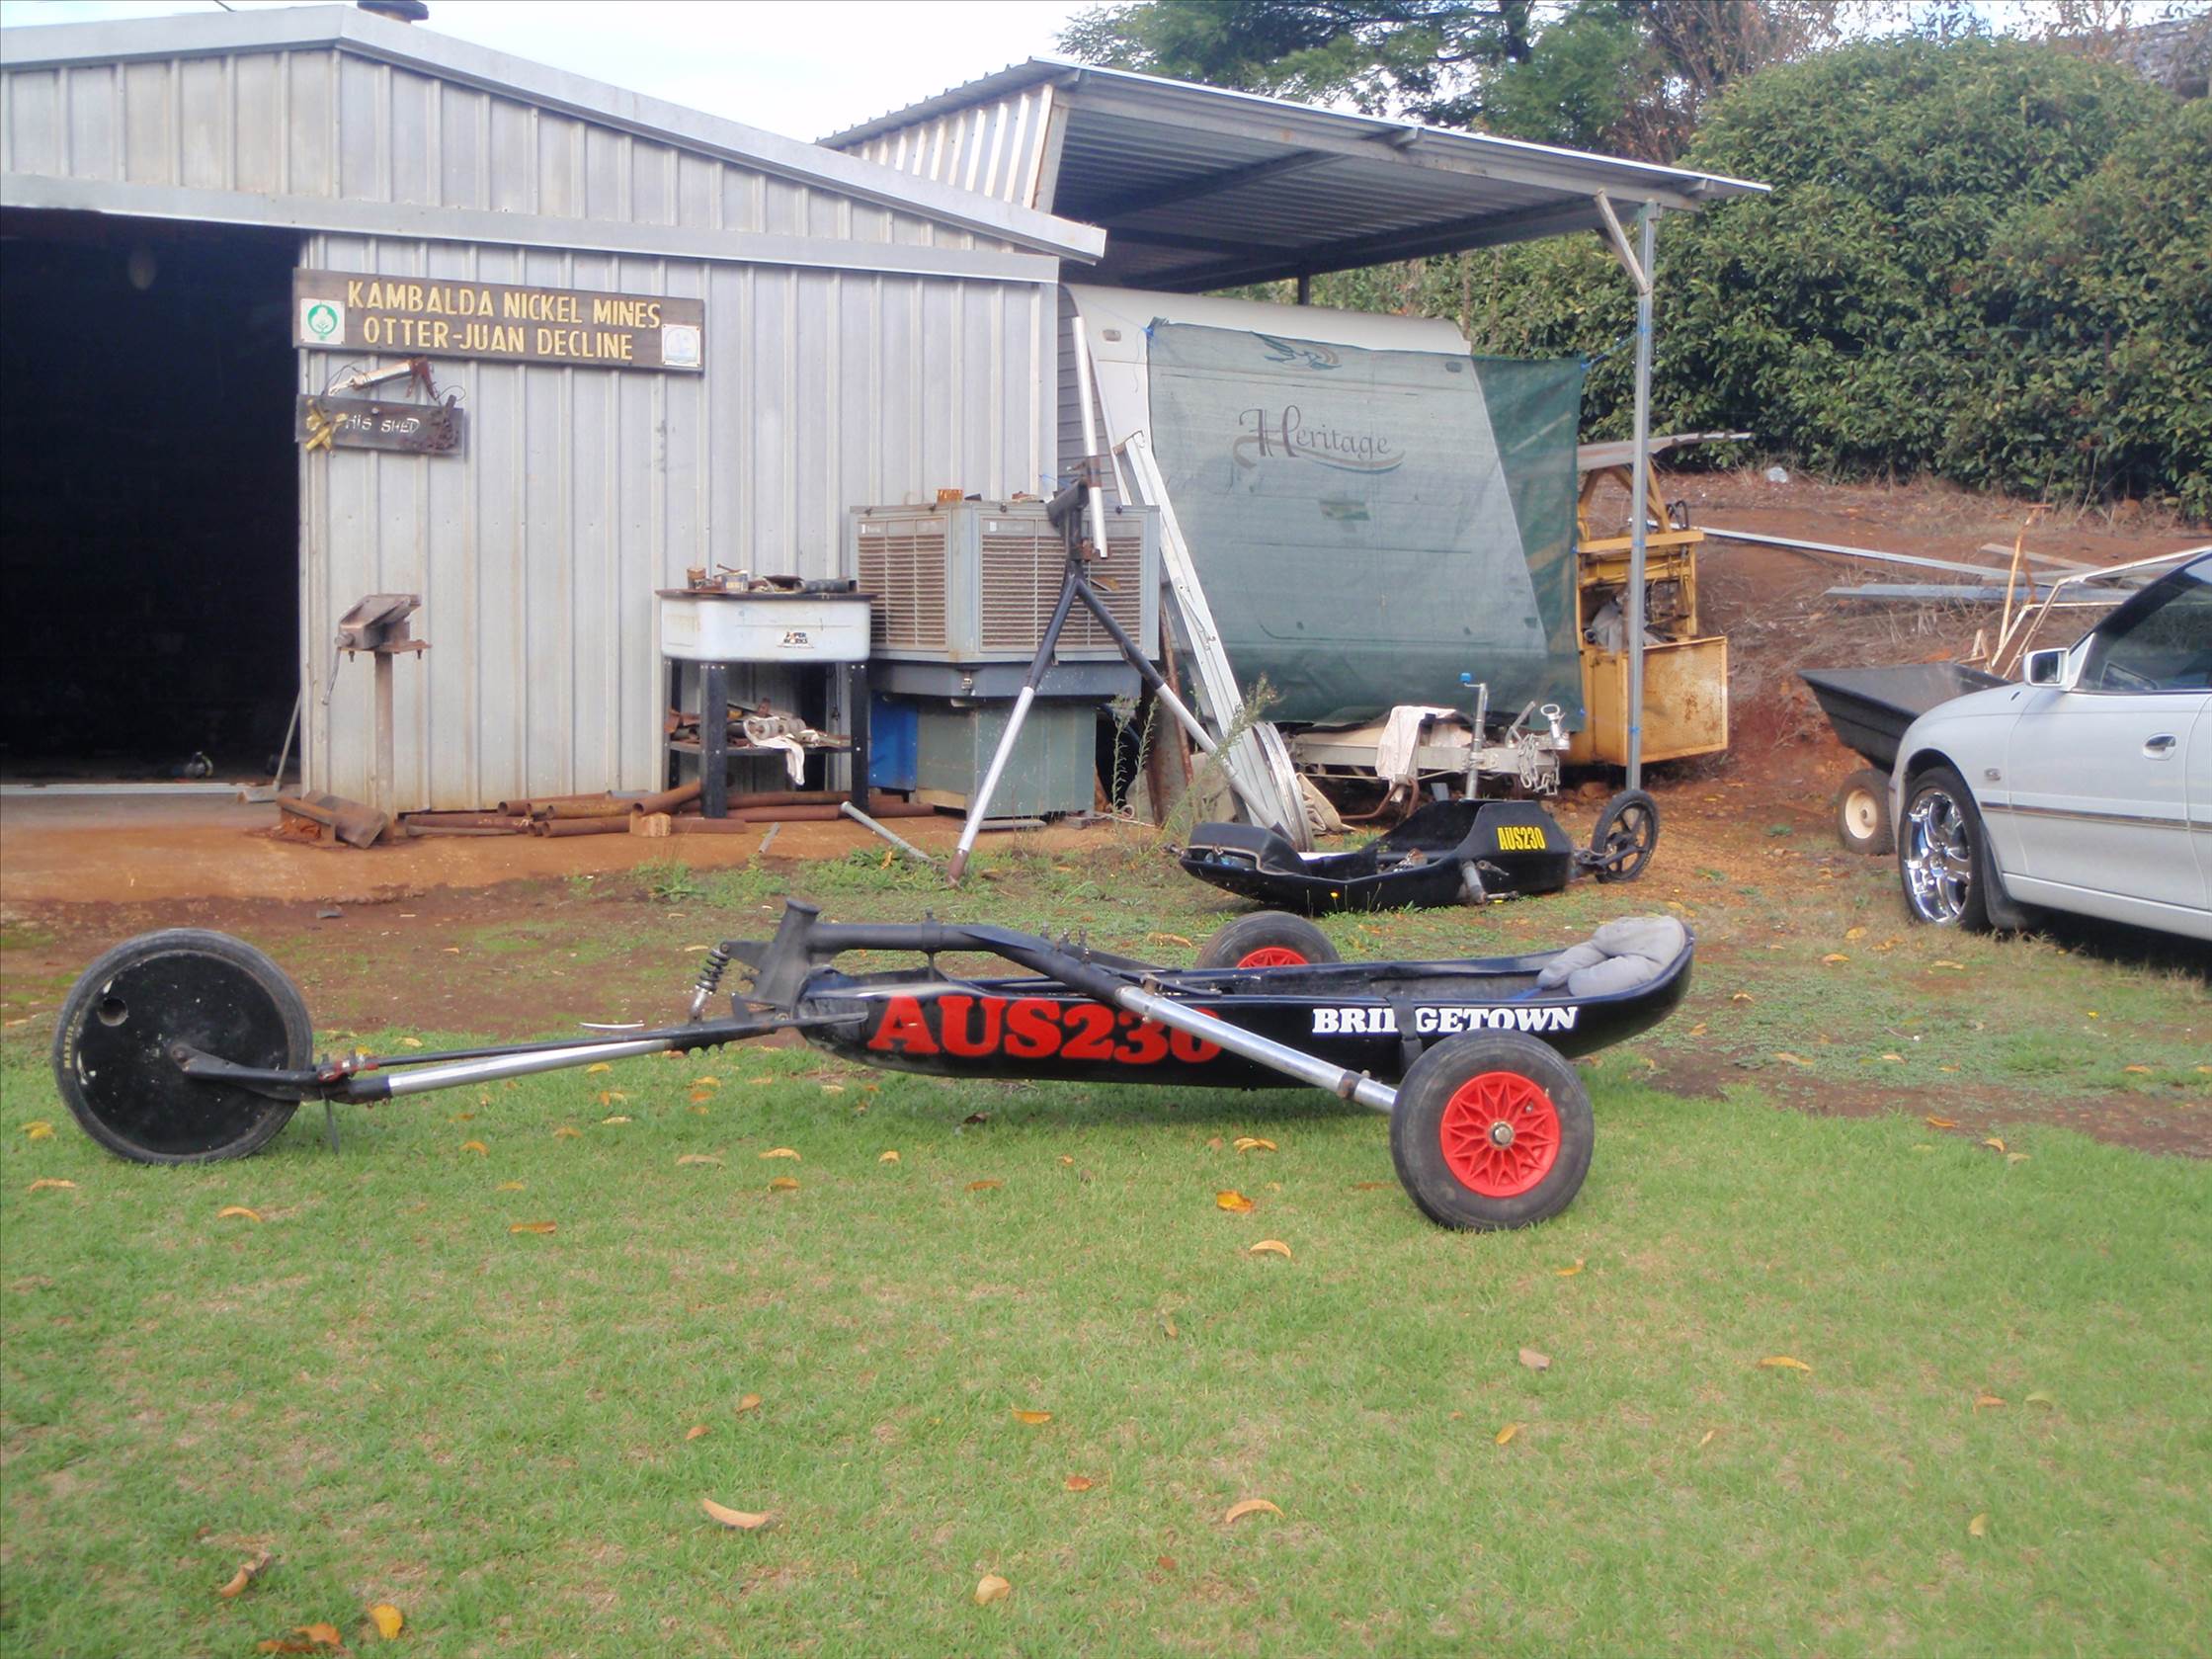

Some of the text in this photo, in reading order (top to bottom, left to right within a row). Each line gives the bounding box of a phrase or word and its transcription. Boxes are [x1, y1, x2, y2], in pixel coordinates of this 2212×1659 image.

[348, 281, 661, 329] KAMBALDA NICKEL MINES
[364, 316, 633, 361] OTTER-JUAN DECLINE
[380, 417, 421, 434] SHED
[1239, 405, 1391, 458] Heritage
[1497, 826, 1546, 851] AUS230
